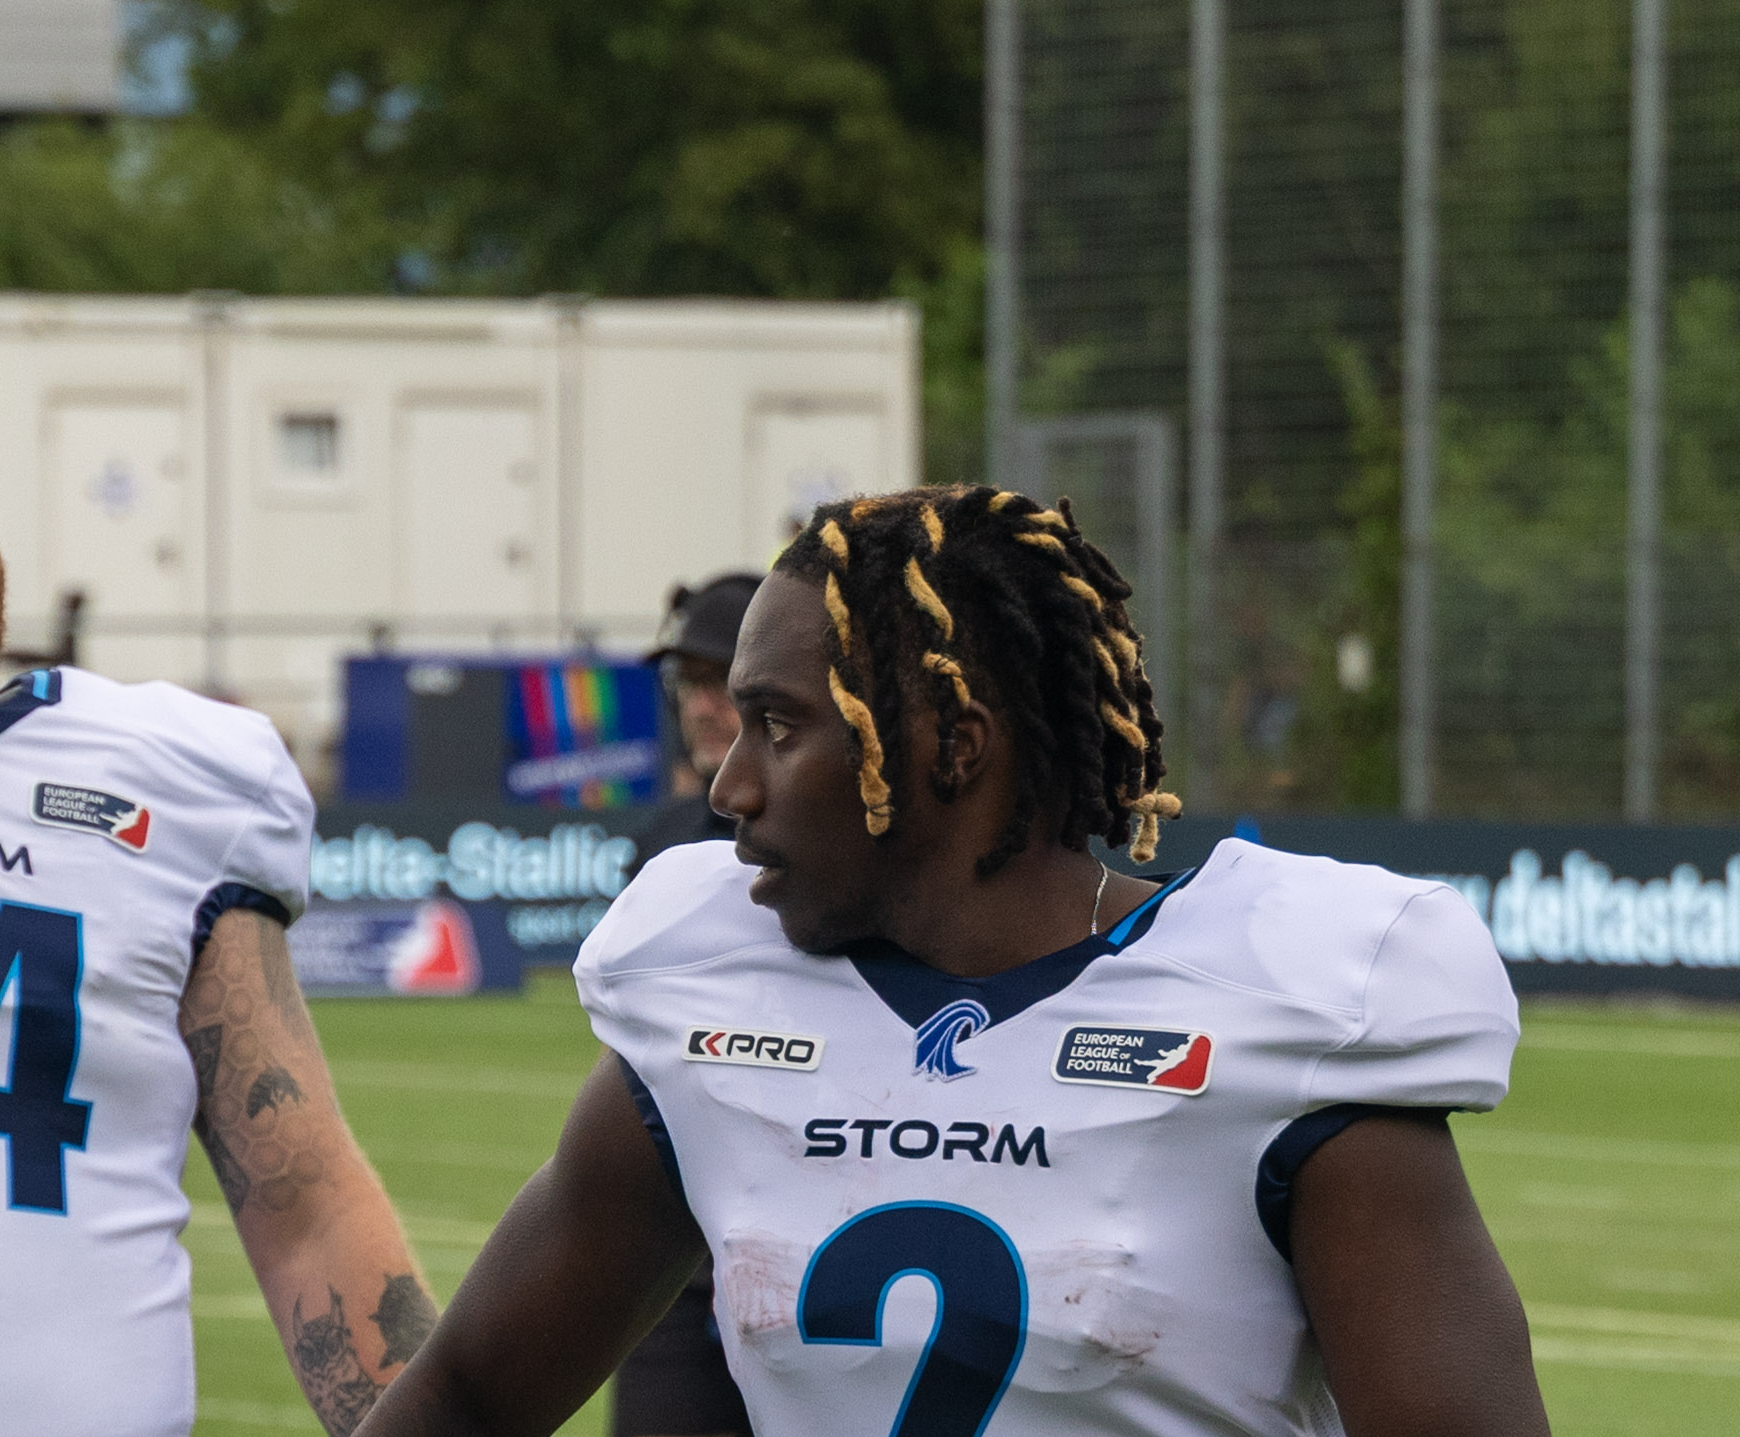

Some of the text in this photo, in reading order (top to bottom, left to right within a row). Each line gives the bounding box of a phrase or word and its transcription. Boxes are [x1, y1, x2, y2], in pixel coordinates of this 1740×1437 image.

[43, 786, 106, 806] EUROPEAN
[43, 796, 86, 813] LEAGUE
[42, 804, 101, 824] FOOTBALL
[1073, 1031, 1144, 1048] EUROPEAN
[1070, 1045, 1119, 1061] LEAGUE
[1066, 1058, 1134, 1075] FOOTBALL
[803, 1117, 1051, 1168] STORM
